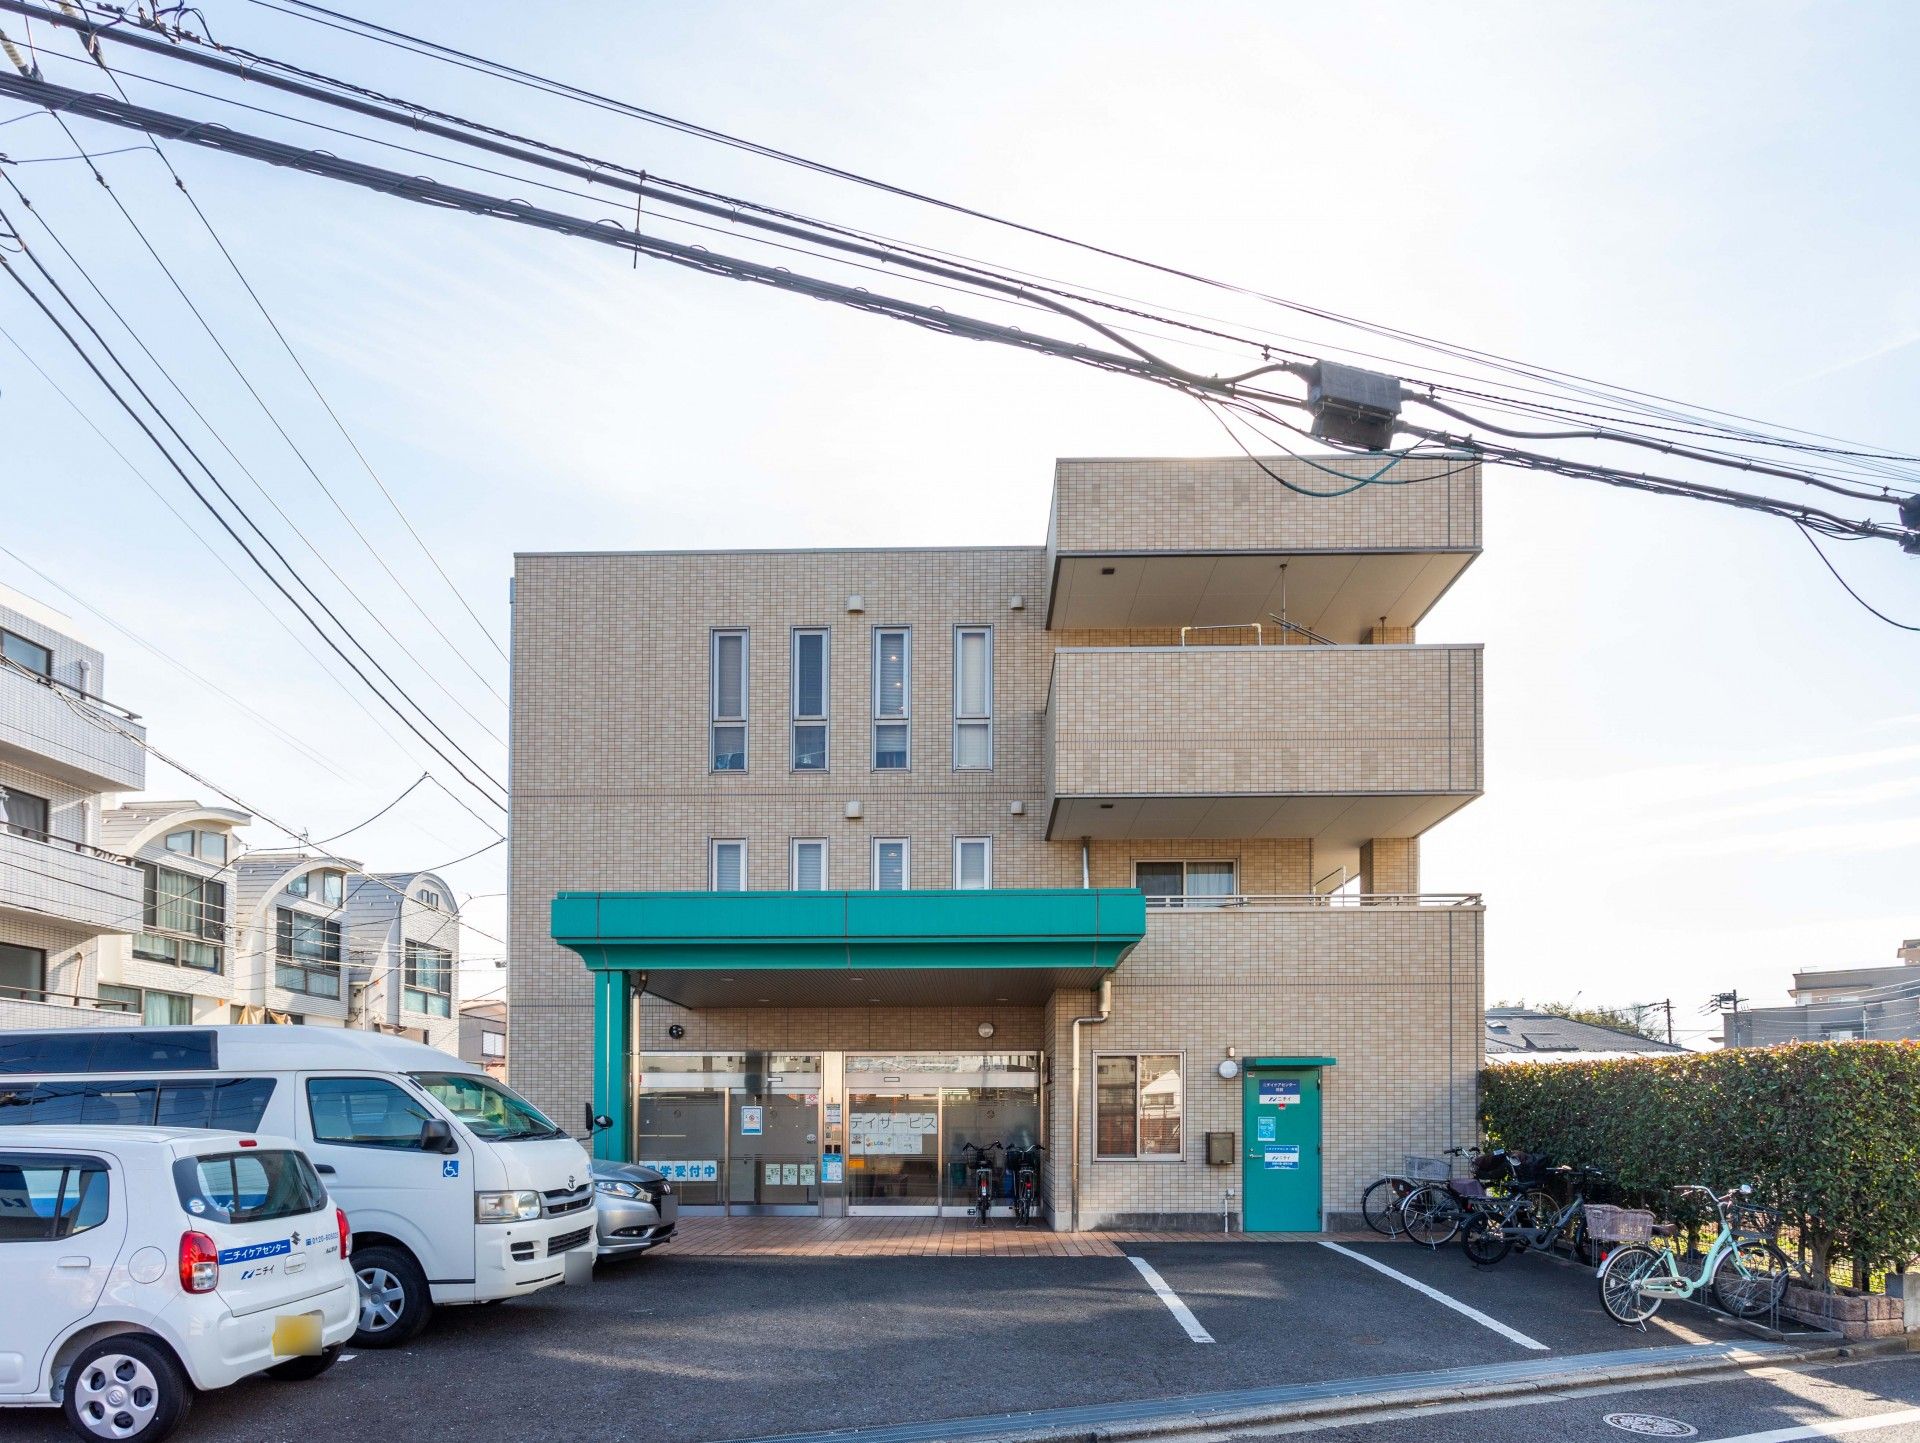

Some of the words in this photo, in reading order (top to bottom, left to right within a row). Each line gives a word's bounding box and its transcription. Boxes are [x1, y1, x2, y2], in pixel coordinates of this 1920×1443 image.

[224, 1244, 288, 1262] ニチイケアセンター
